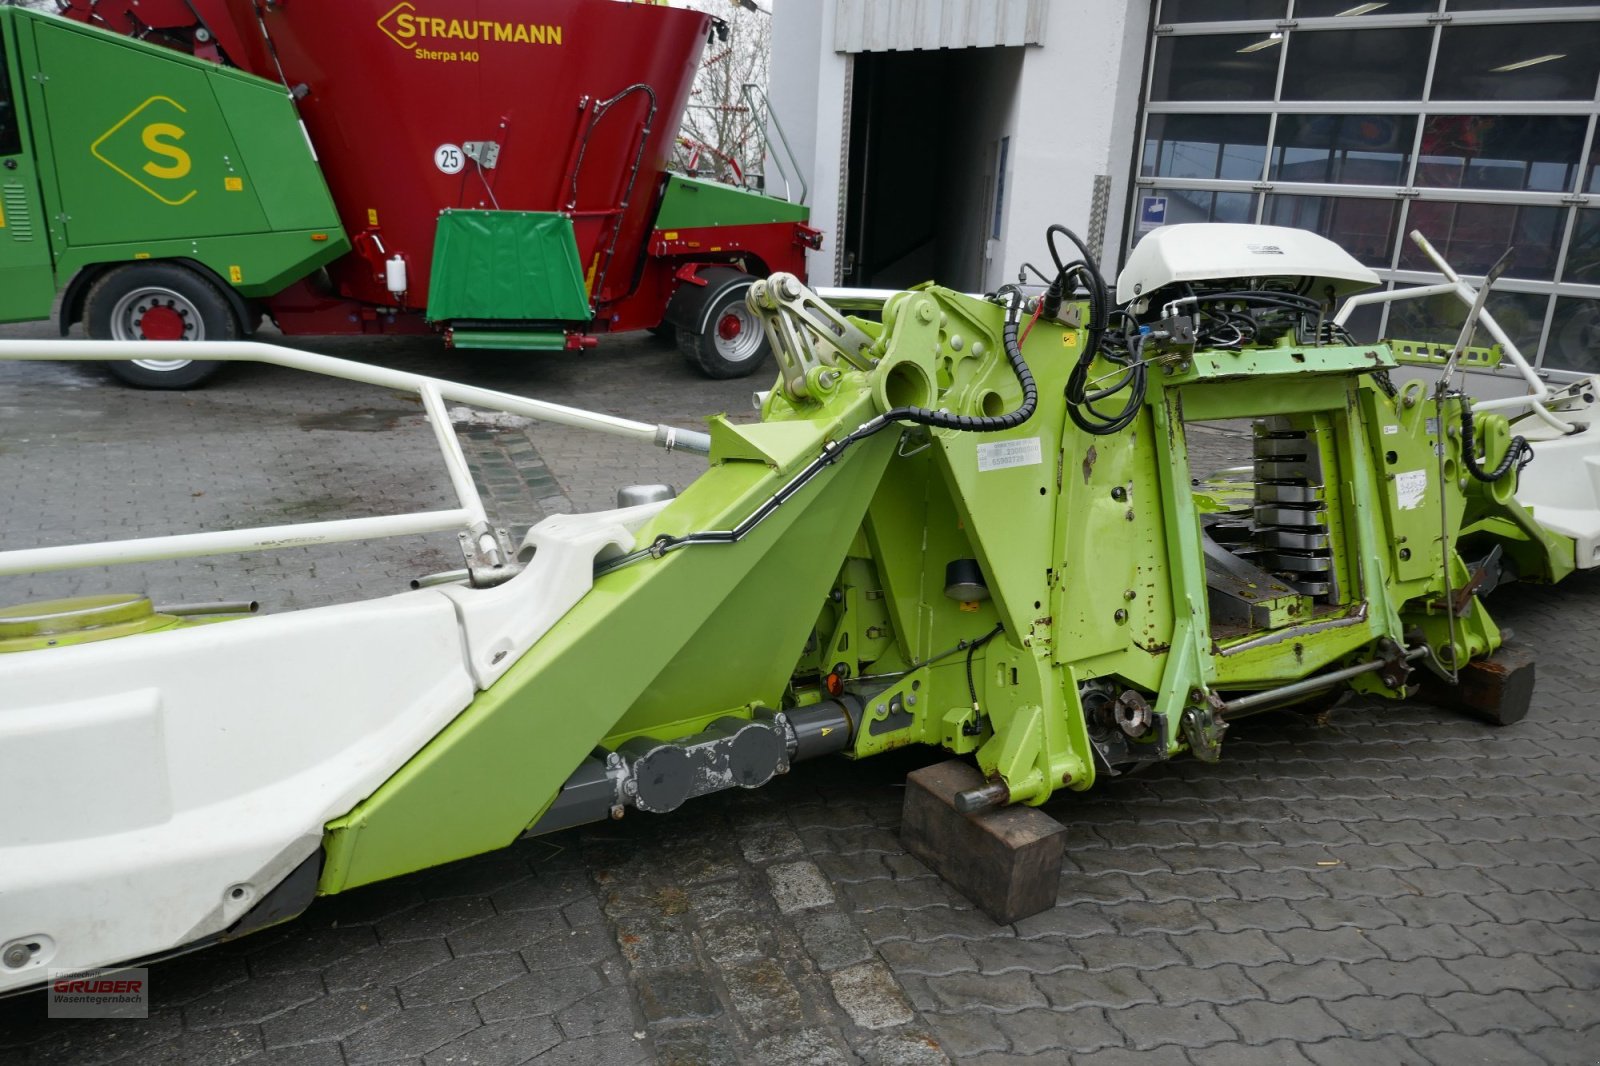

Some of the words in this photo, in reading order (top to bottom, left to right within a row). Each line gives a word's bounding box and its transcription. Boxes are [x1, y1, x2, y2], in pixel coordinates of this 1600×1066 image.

[396, 13, 562, 45] STRAUTMANN
[415, 49, 457, 62] Sherpa
[460, 51, 479, 62] 140
[142, 123, 191, 179] S
[441, 150, 458, 168] 25
